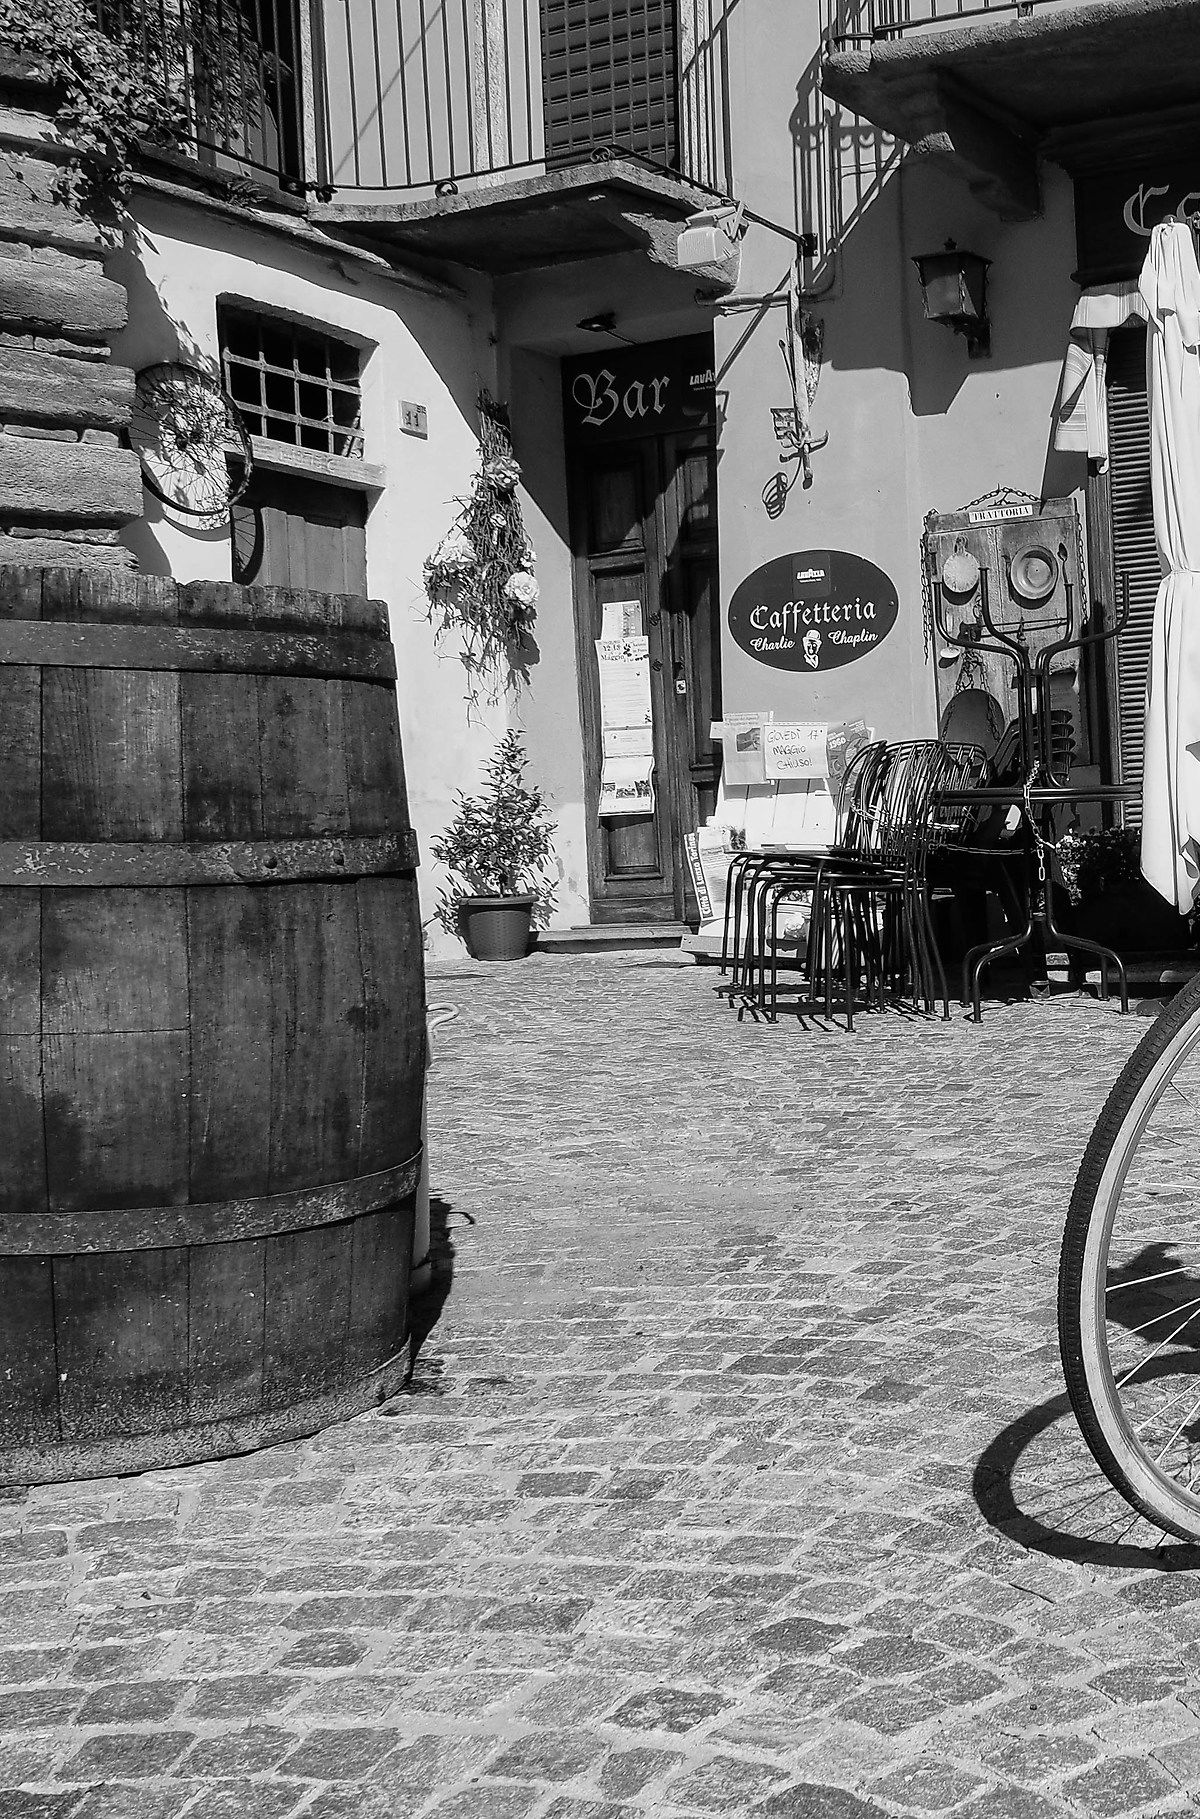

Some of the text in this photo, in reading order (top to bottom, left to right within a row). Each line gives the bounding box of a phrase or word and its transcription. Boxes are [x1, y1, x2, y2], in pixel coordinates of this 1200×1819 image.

[572, 369, 670, 426] Bar
[973, 506, 1030, 521] TRATTORIA
[750, 597, 876, 635] Caffetteria
[750, 628, 878, 652] Charlie Chaplin
